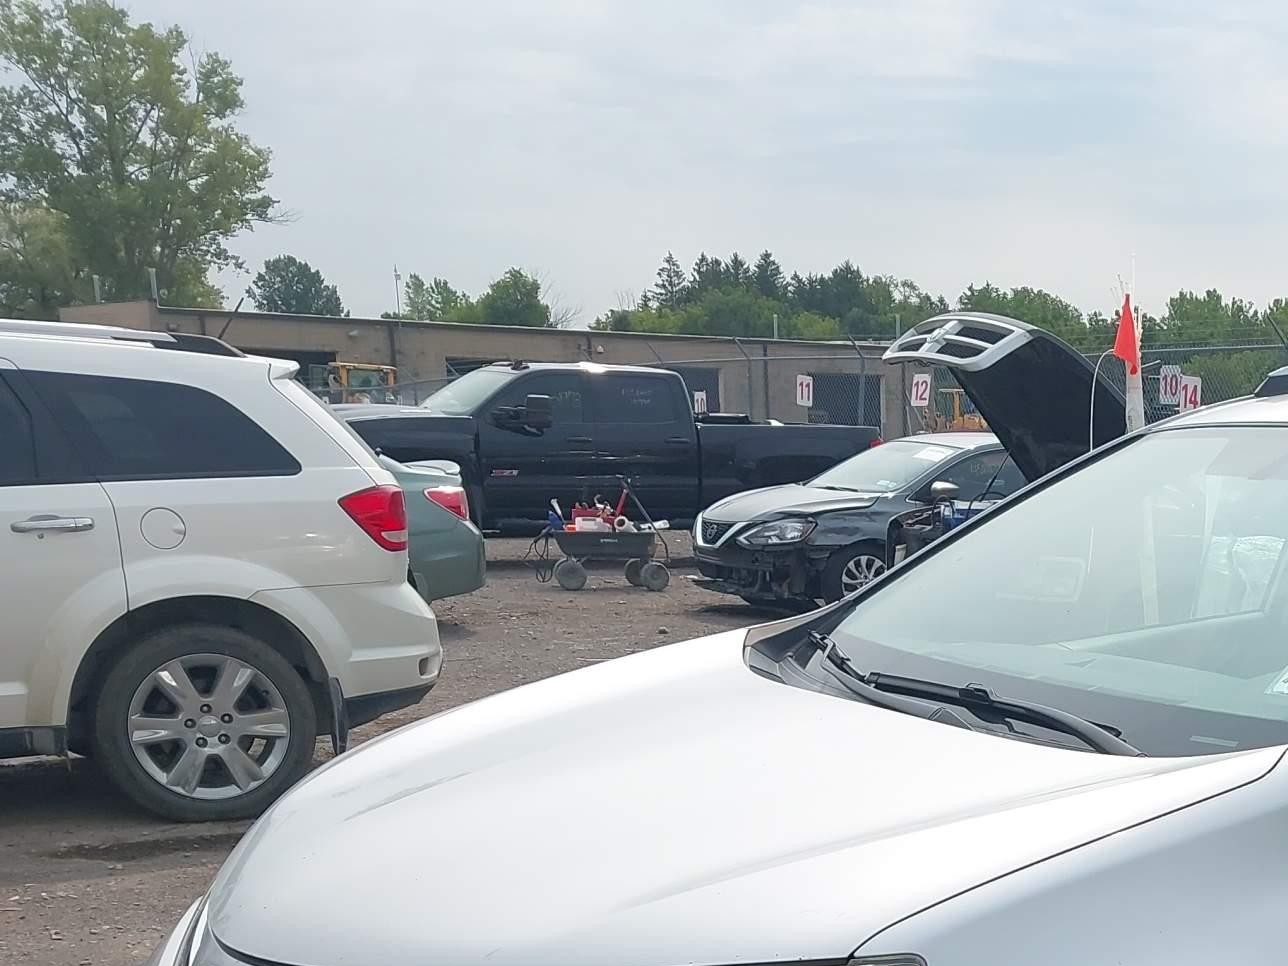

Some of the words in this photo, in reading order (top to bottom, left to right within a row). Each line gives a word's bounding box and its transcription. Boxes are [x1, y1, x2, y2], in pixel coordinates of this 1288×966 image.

[798, 380, 812, 401] 11
[913, 379, 929, 401] 12
[1162, 374, 1179, 397] 10
[1182, 384, 1199, 410] 14
